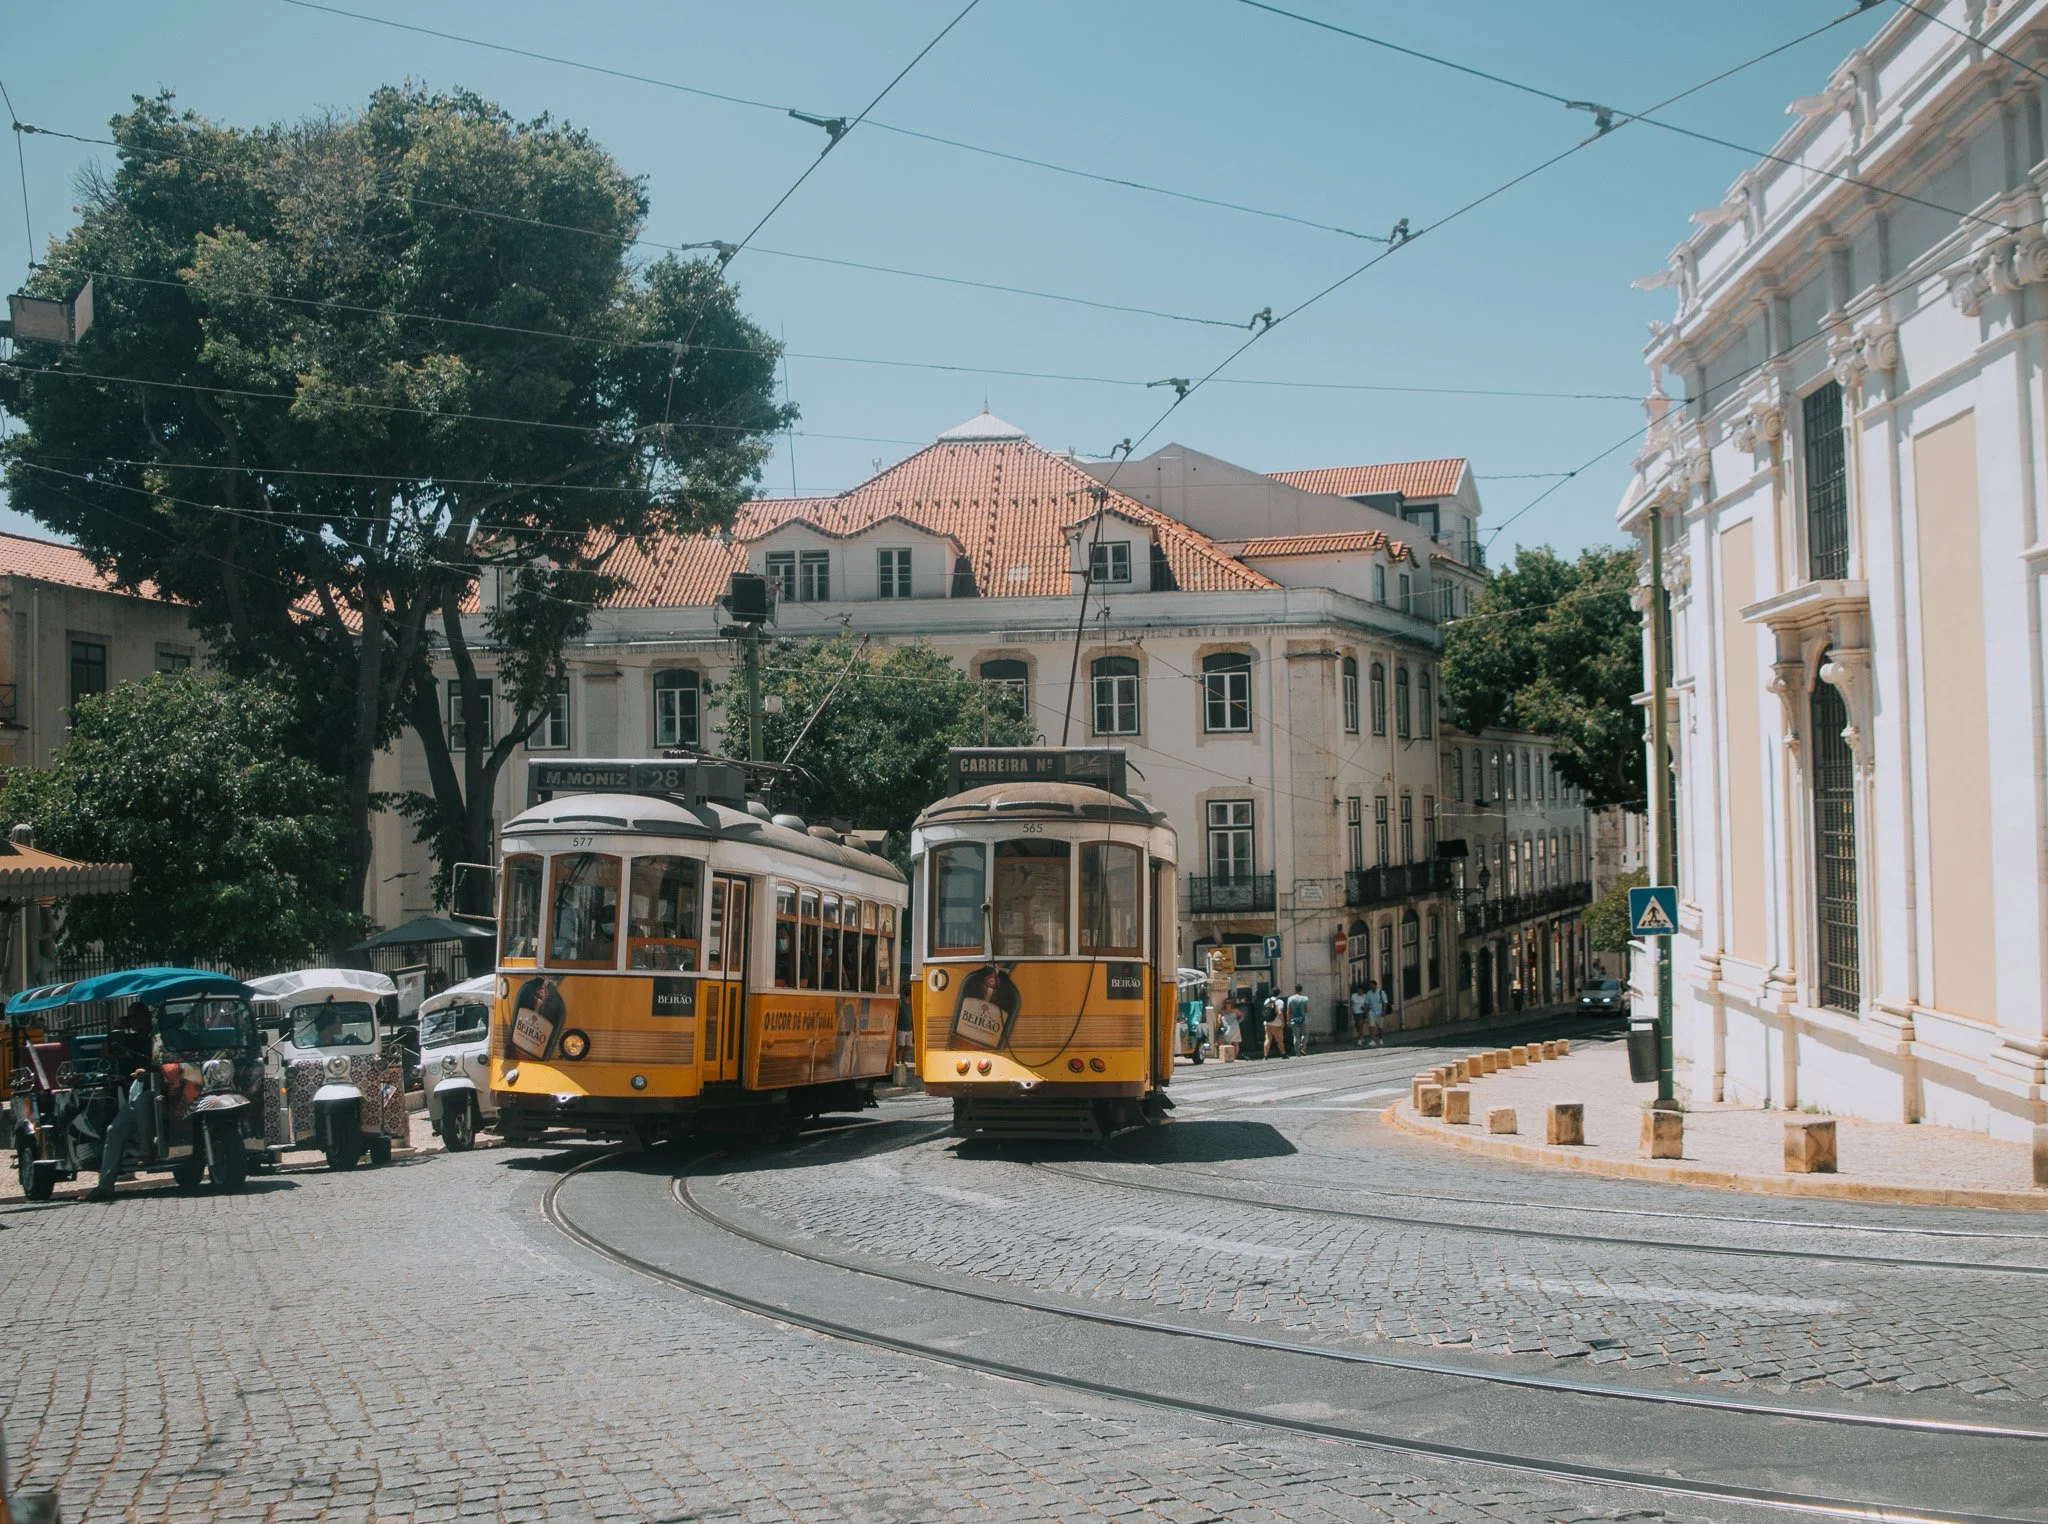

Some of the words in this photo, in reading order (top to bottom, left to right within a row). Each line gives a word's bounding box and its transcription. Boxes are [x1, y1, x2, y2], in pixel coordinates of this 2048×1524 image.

[960, 758, 1028, 772] CARREIRA
[545, 771, 628, 785] M.MONIZ
[651, 769, 679, 788] 28
[1022, 823, 1043, 833] 565
[572, 837, 594, 847] 577
[1267, 938, 1277, 957] P
[1111, 978, 1141, 988] BEIRÃO
[657, 994, 692, 1005] BEIRÃO
[771, 1011, 792, 1031] LICOR
[962, 1010, 1000, 1033] BEIRÃO
[516, 1019, 547, 1044] BEIRÃO
